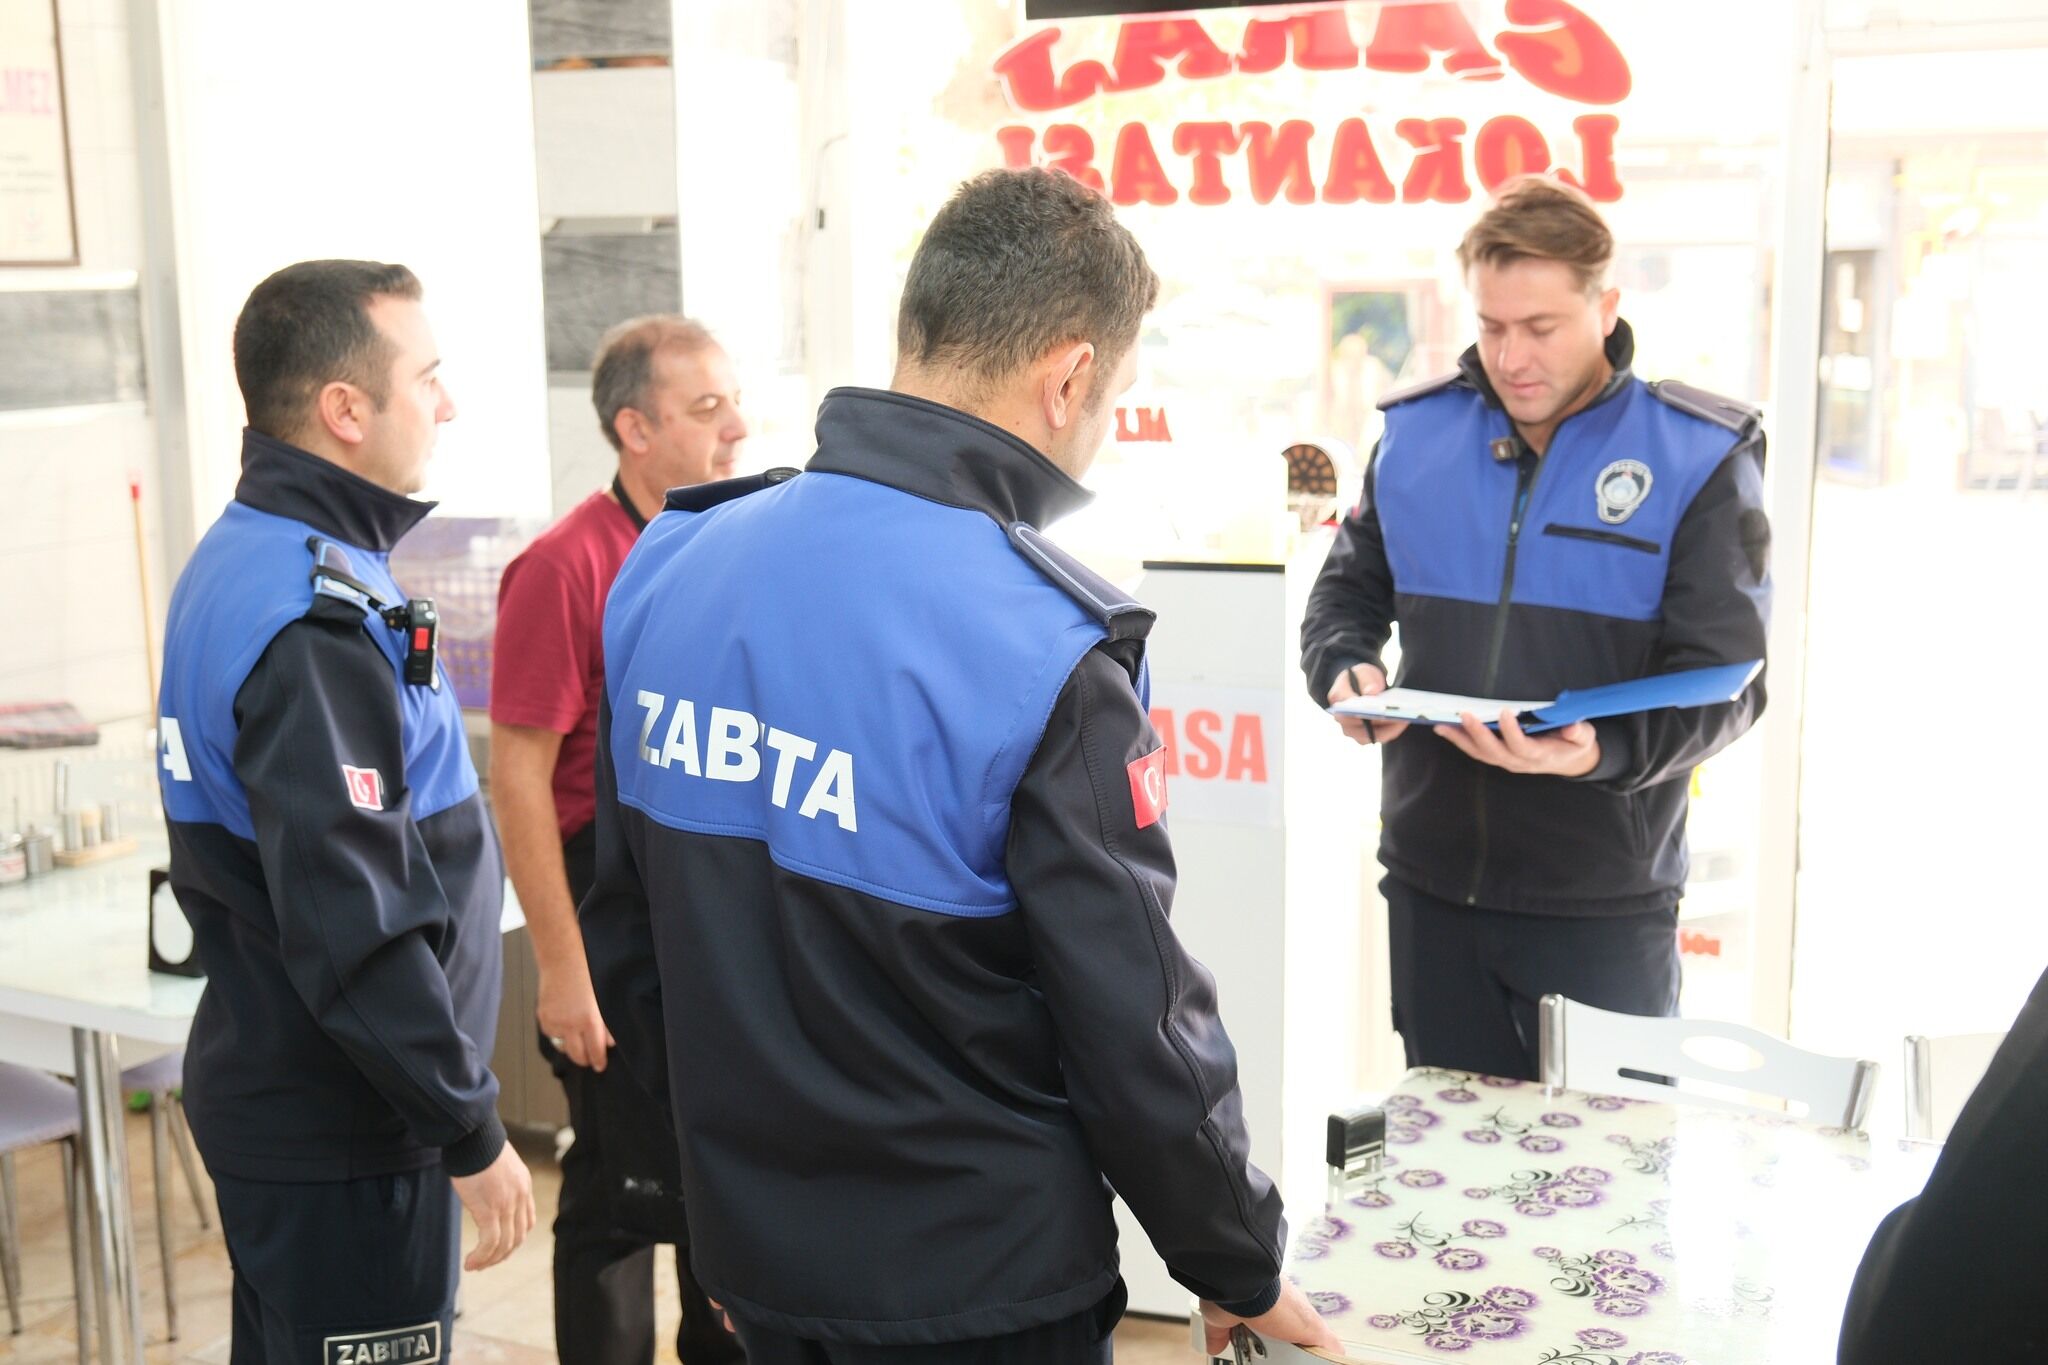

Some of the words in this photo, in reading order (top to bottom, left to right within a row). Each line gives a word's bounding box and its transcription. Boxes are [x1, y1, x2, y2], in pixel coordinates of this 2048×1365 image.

[637, 690, 858, 833] ZABTA
[1149, 708, 1268, 783] ASA
[337, 1334, 430, 1365] ZABITA
